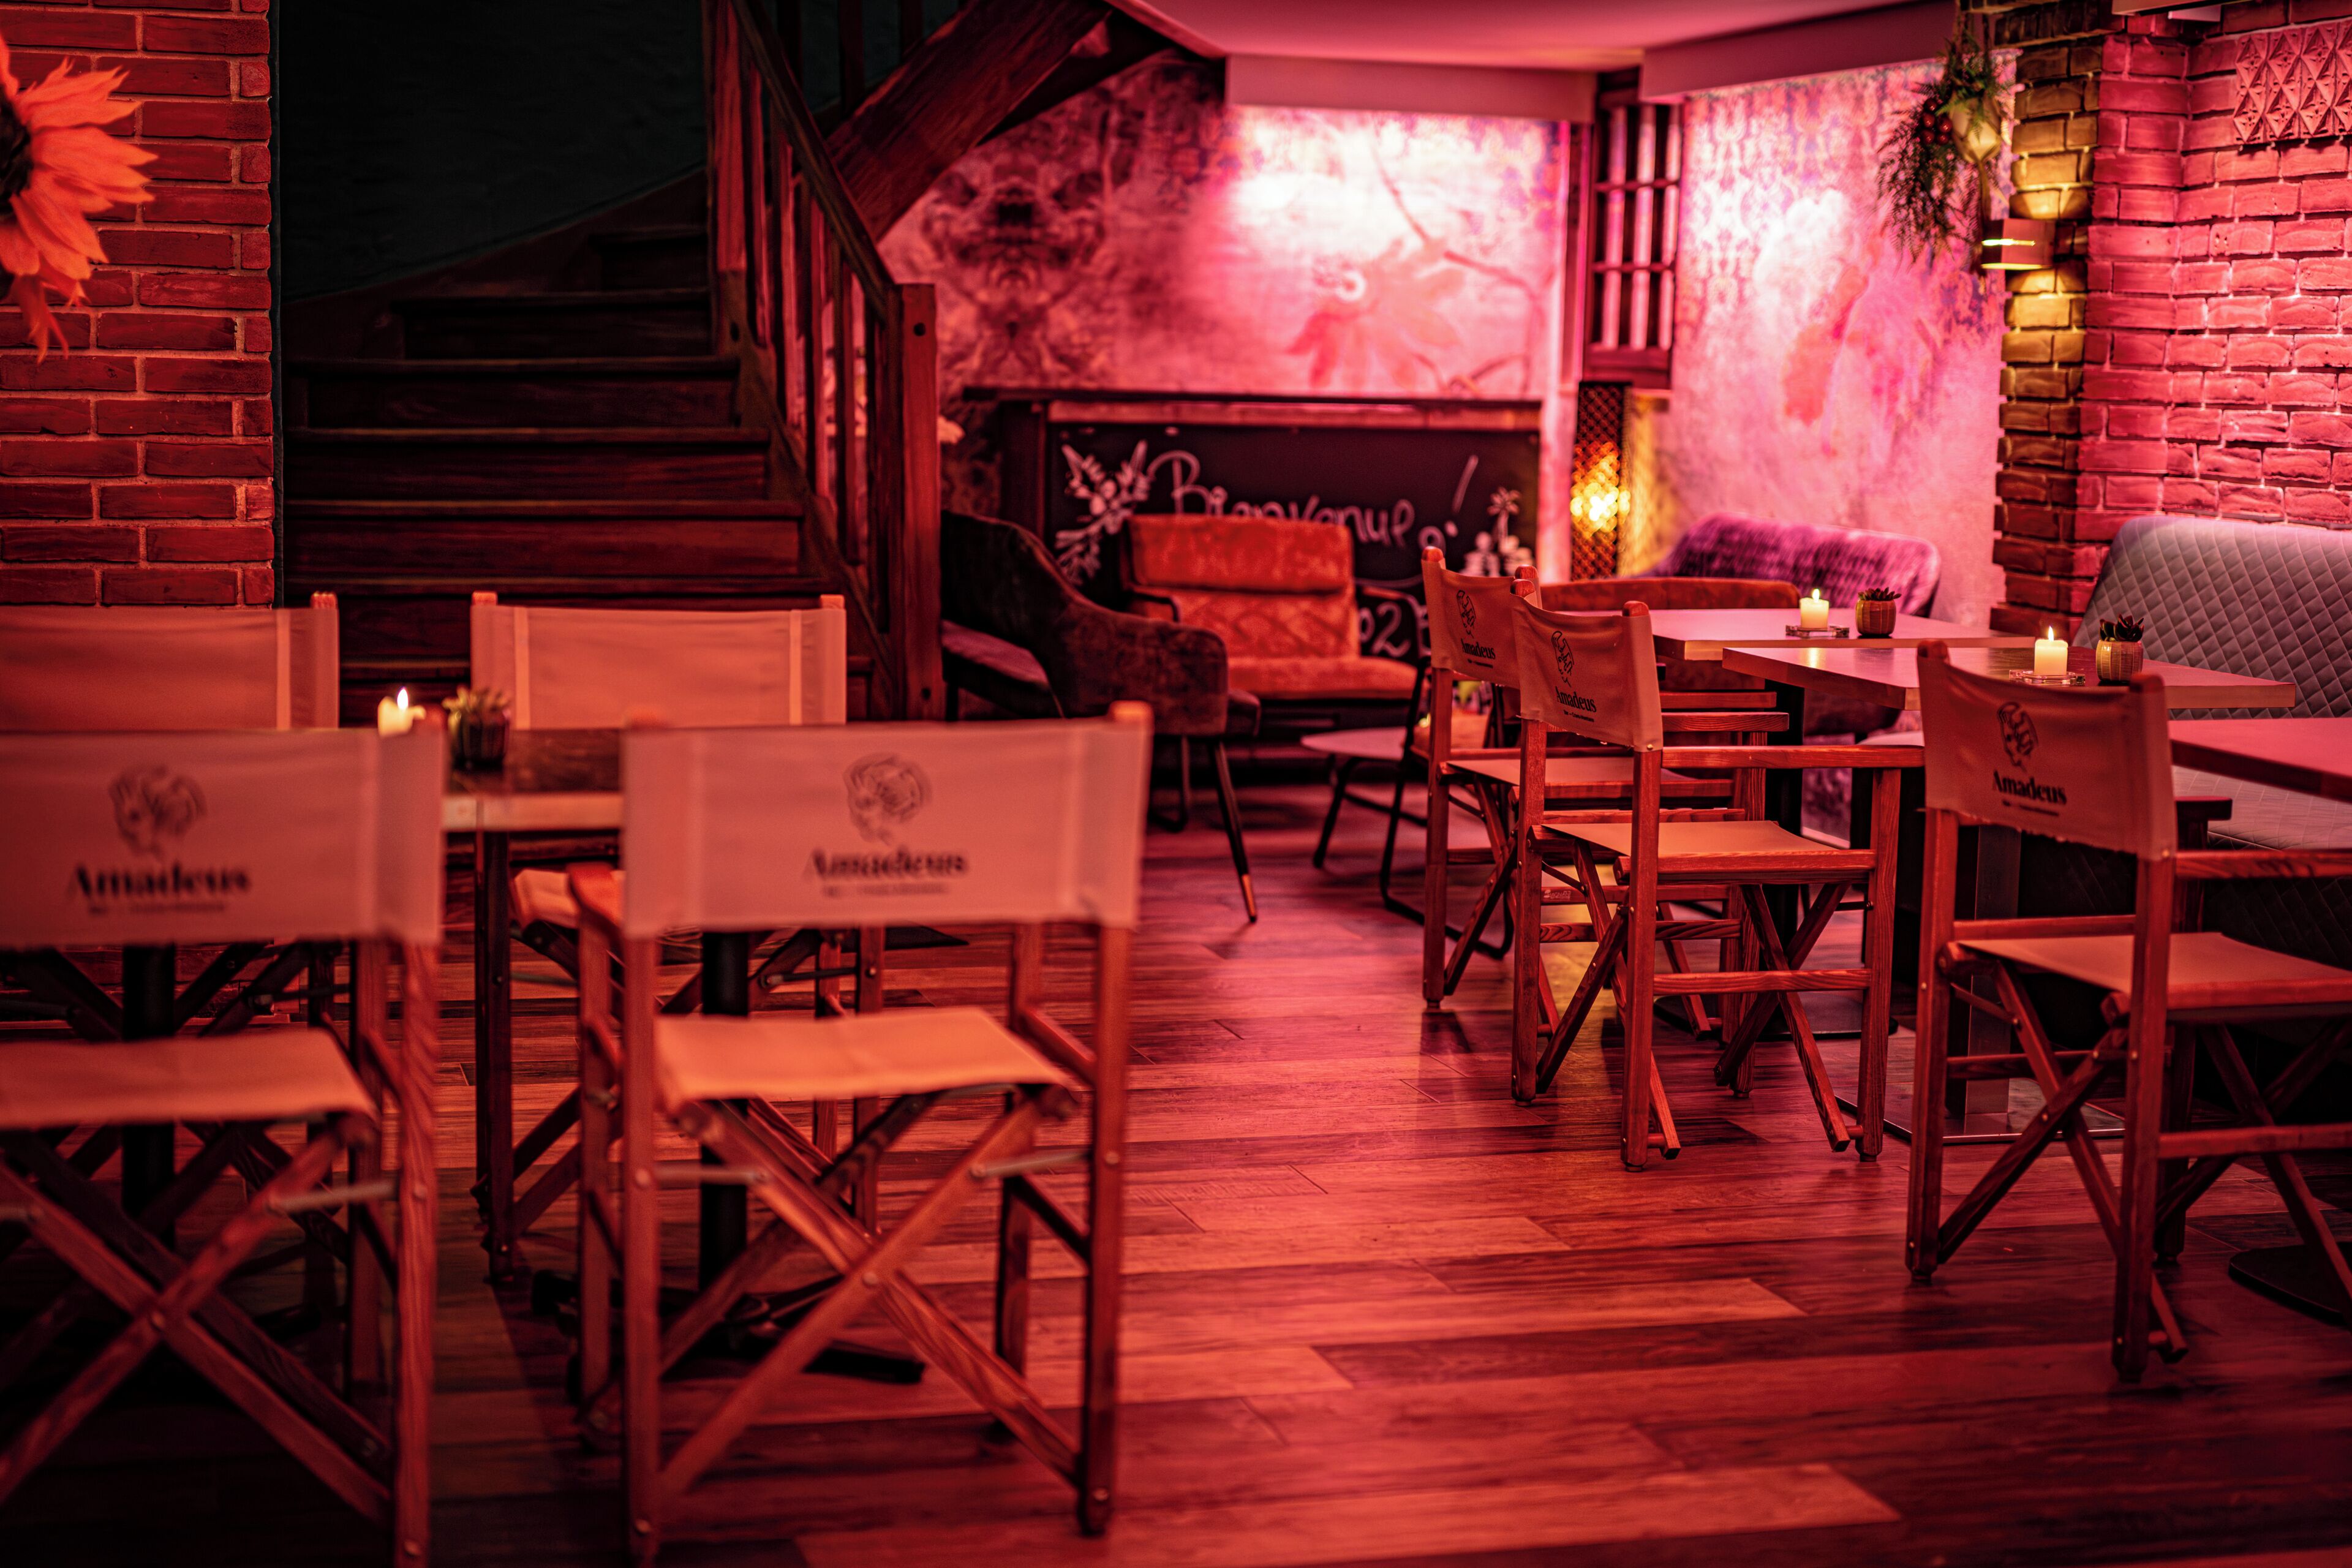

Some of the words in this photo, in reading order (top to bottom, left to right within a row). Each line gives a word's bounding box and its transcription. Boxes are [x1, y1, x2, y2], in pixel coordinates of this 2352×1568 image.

[1461, 638, 1496, 660] Amadeus
[1555, 686, 1597, 713] Amadeus
[1992, 770, 2067, 805] Amadeus
[67, 861, 252, 900] Amadeus
[802, 845, 968, 881] Amadeus
